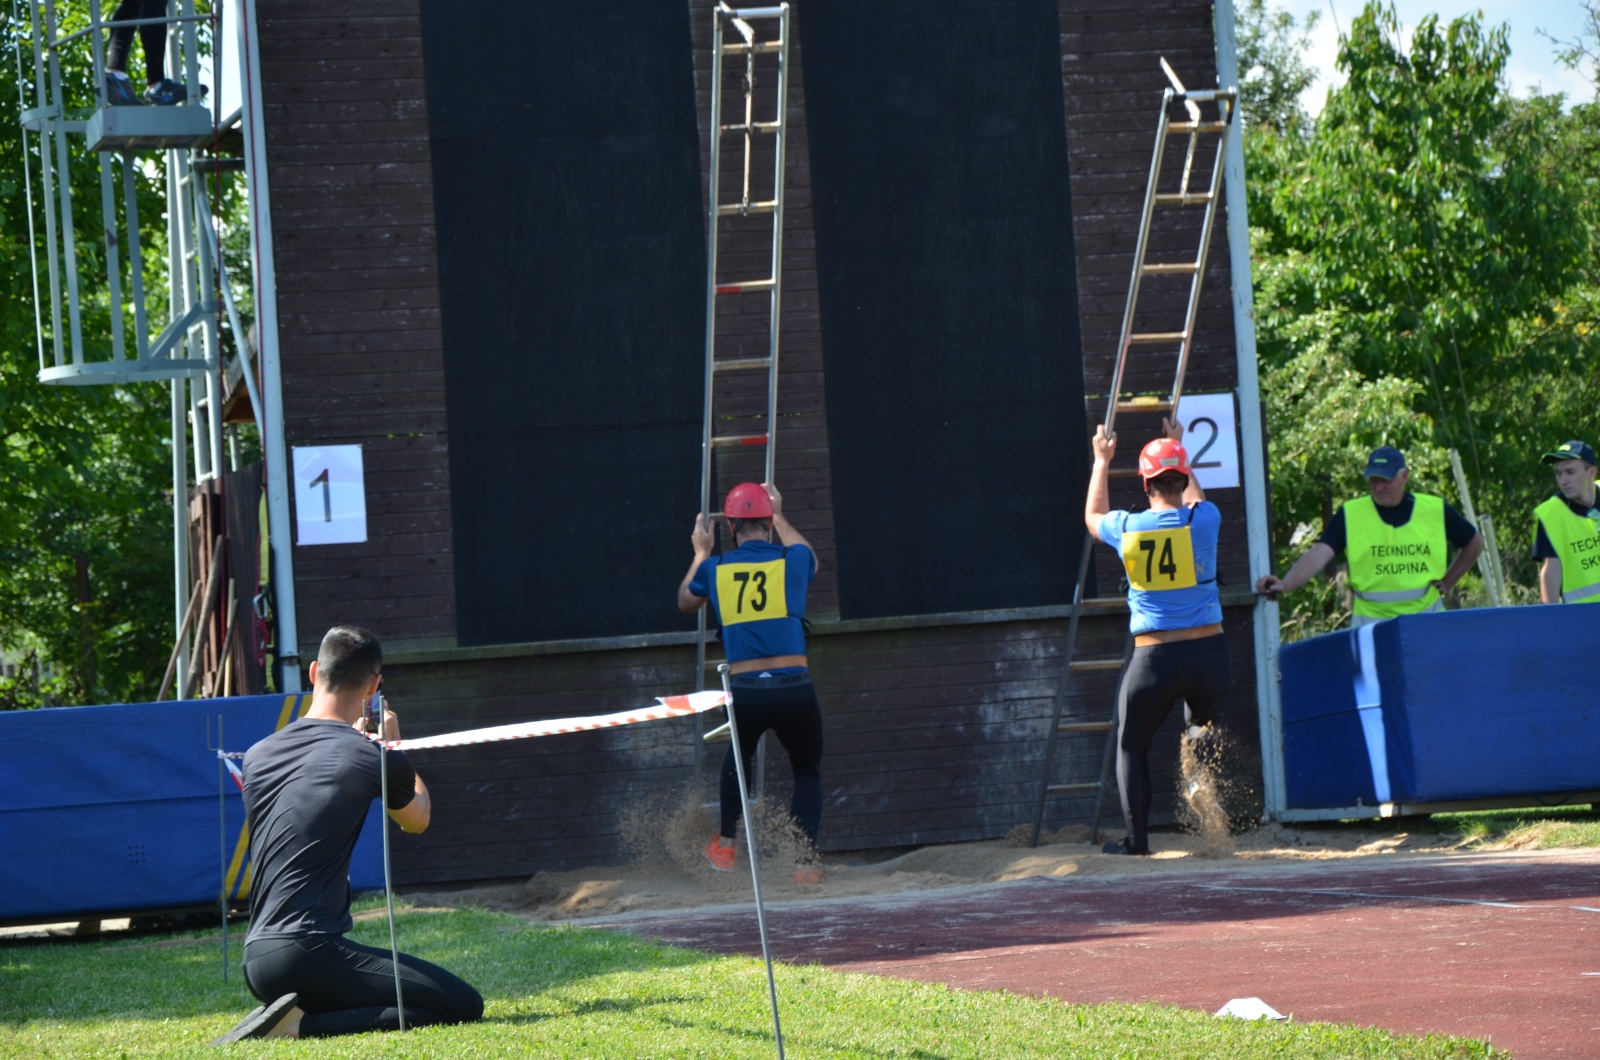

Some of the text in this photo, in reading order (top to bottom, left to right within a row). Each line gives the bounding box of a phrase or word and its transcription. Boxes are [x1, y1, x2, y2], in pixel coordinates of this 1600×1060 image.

[1187, 417, 1222, 469] 2
[309, 468, 332, 523] 1
[1139, 537, 1177, 583] 74
[1375, 562, 1429, 575] SKUPINA
[1581, 554, 1600, 570] SK
[733, 570, 767, 614] 73
